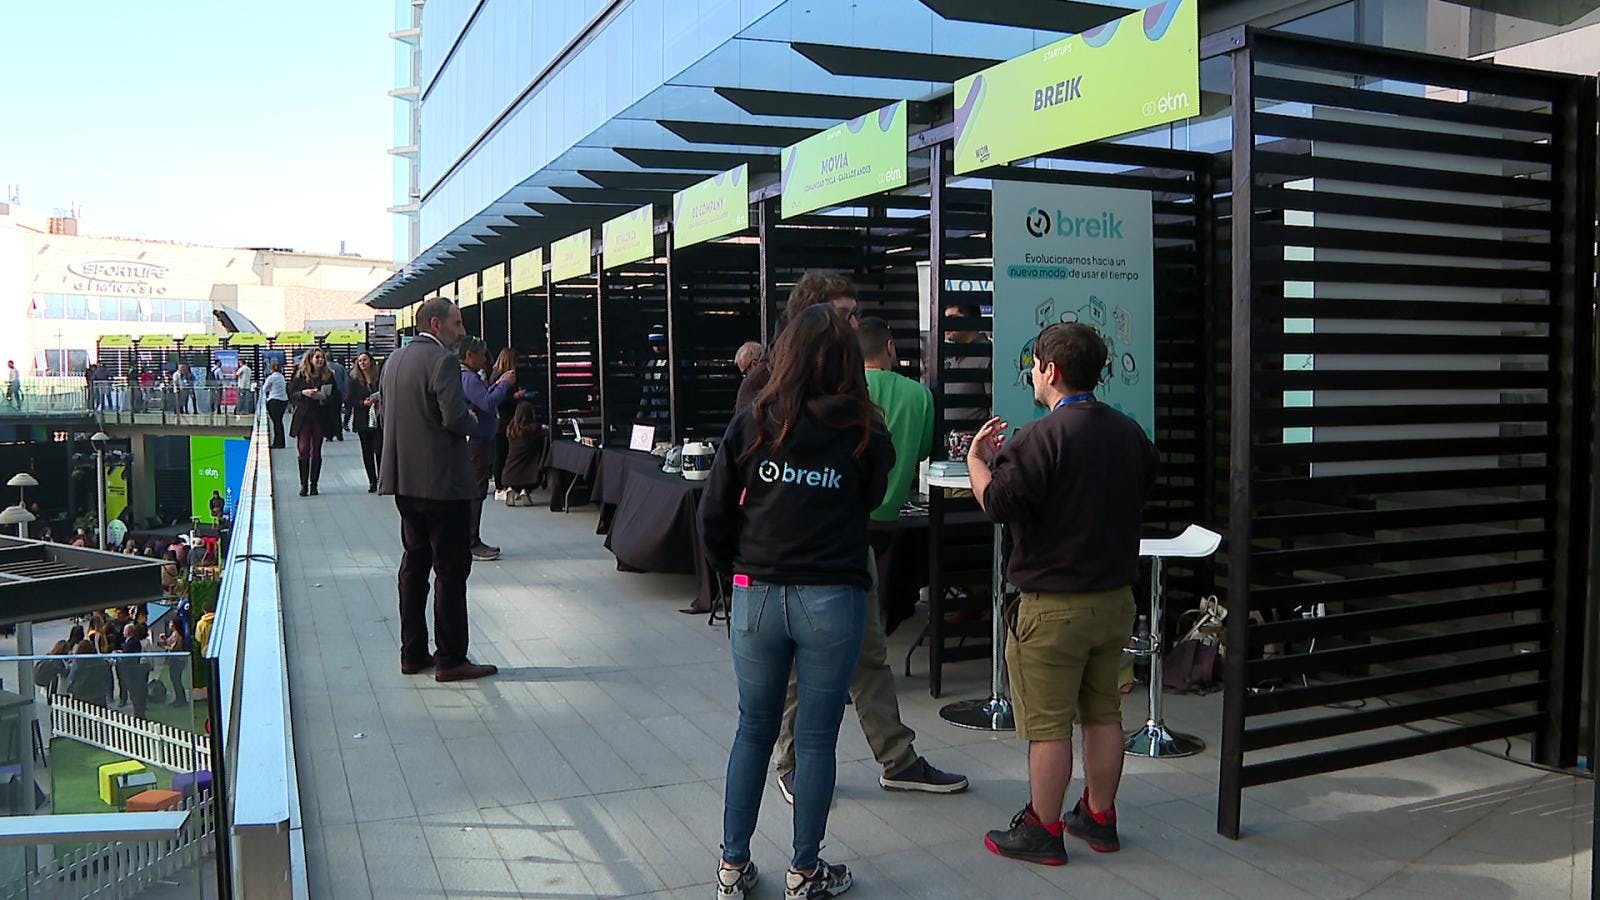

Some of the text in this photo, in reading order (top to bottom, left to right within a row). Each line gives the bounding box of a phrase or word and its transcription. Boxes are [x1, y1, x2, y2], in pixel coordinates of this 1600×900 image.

[1033, 75, 1083, 111] BREIK
[1158, 91, 1190, 113] etm
[821, 152, 848, 174] MOVIA
[856, 165, 871, 176] ANDES
[1056, 210, 1124, 239] breik
[1025, 253, 1091, 266] Evolucionamos
[1092, 256, 1114, 267] hacia
[1010, 268, 1139, 282] nuevo modo de usar el tiempo
[782, 461, 842, 488] breik
